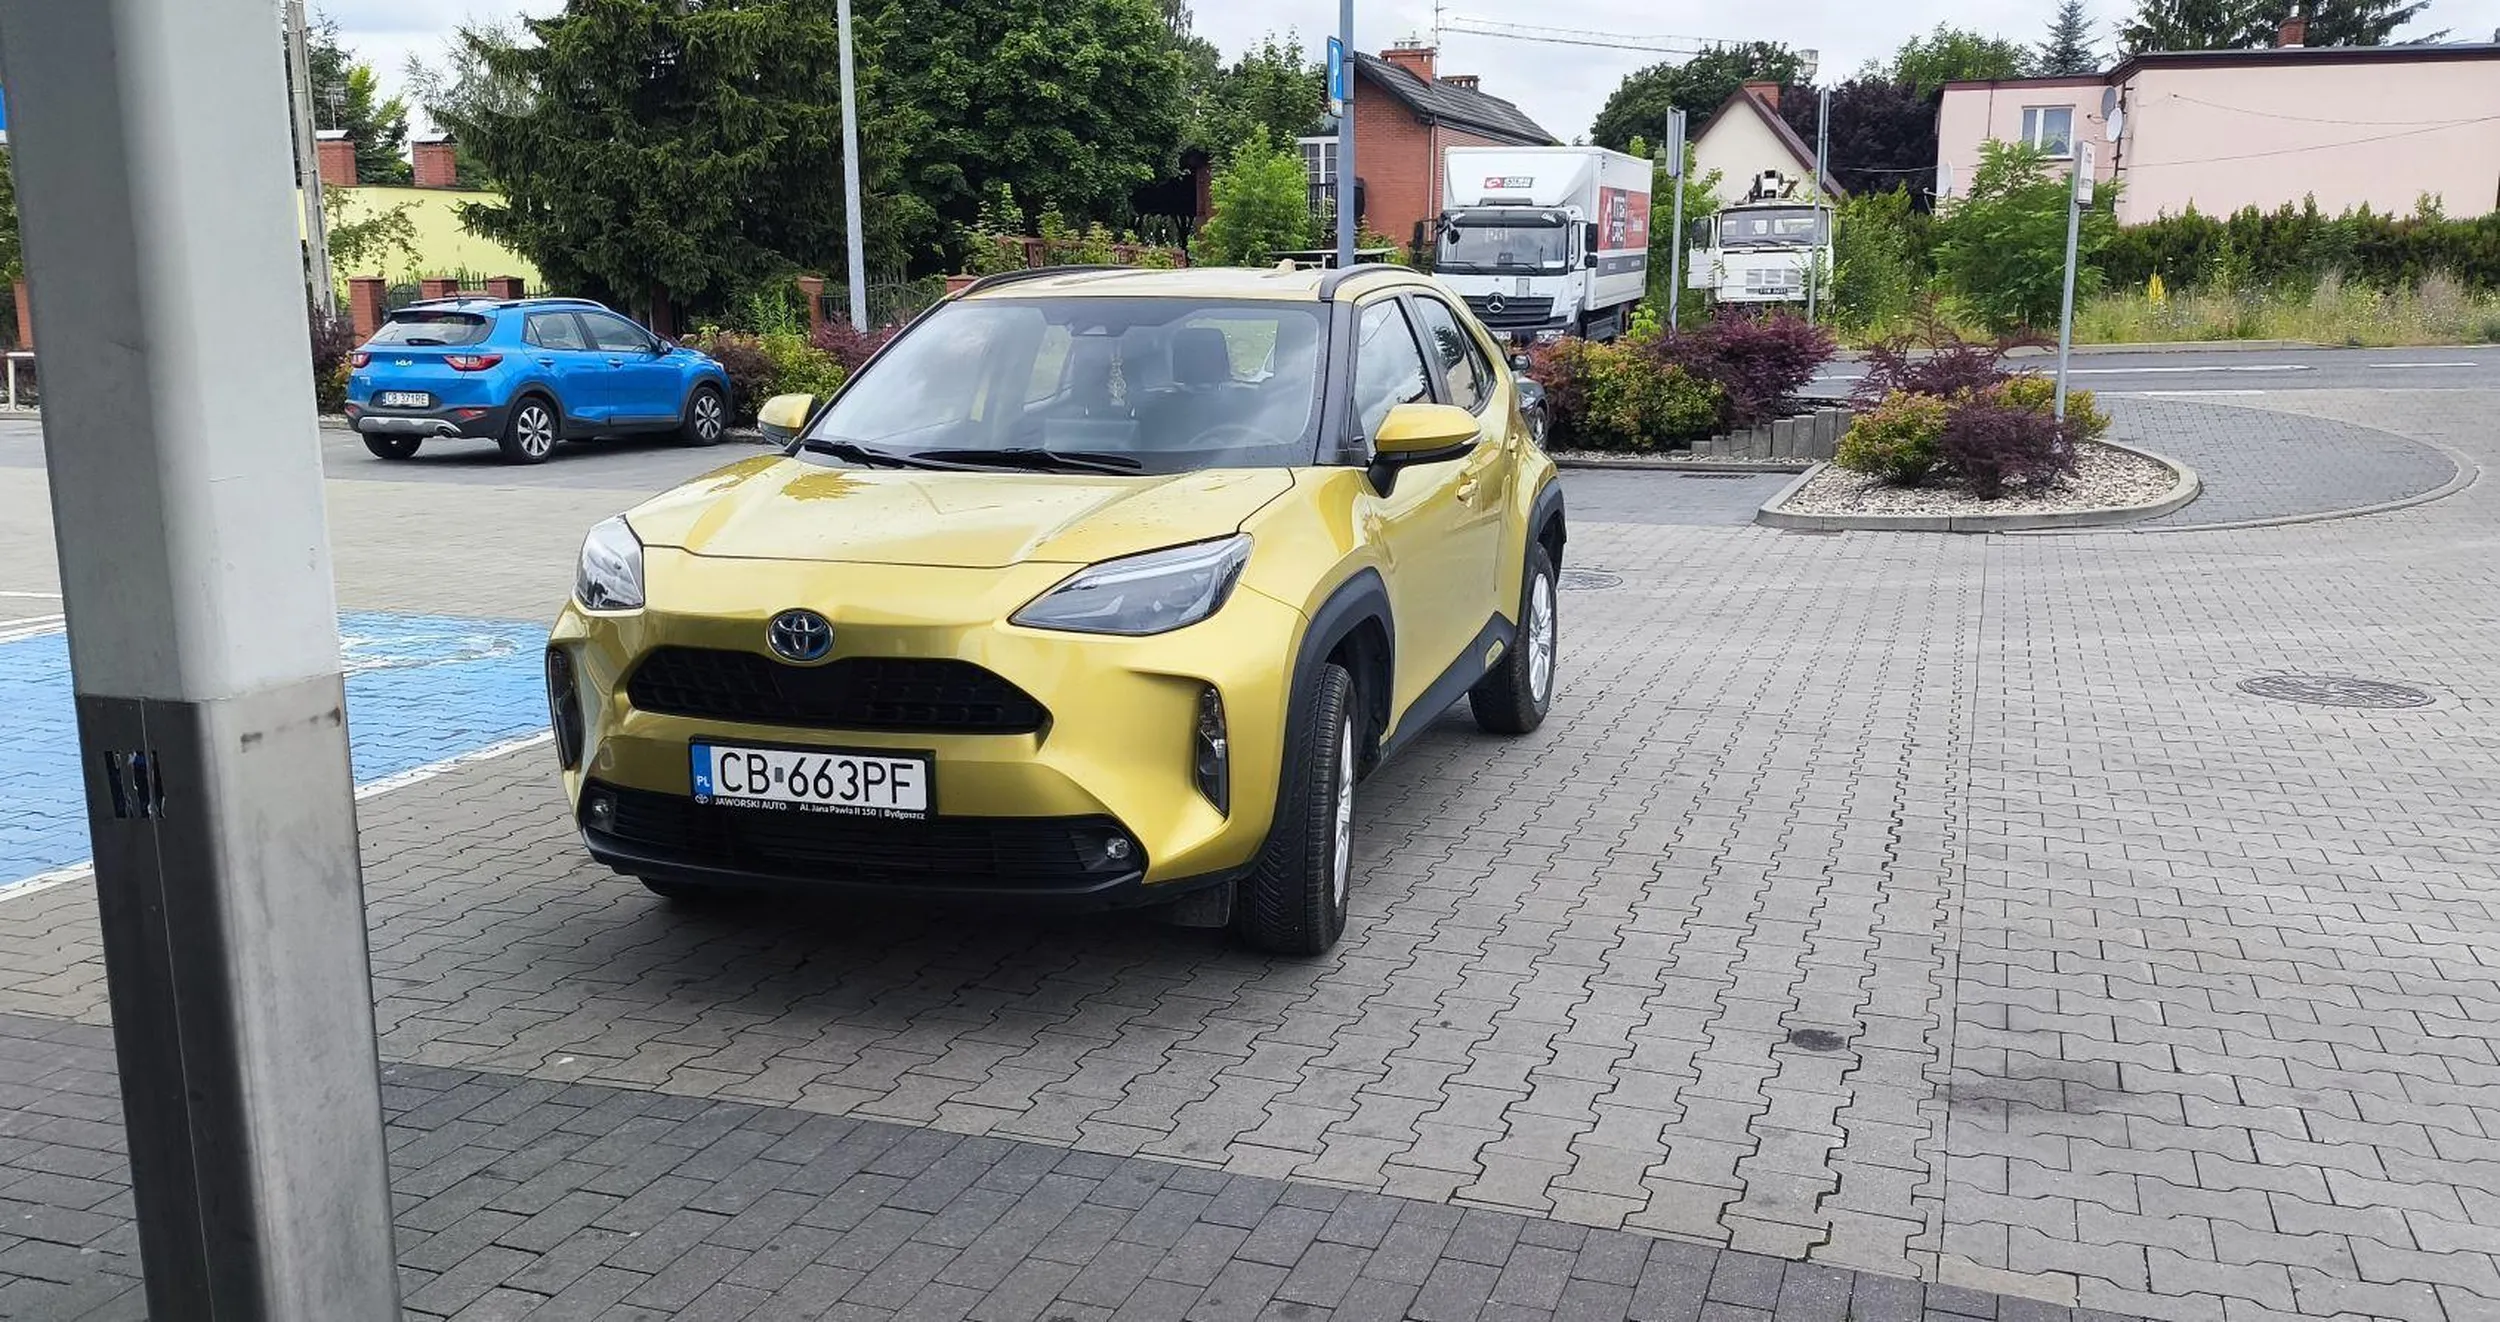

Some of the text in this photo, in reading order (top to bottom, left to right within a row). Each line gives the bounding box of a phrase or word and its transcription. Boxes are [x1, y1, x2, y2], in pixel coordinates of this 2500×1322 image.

[697, 776, 710, 788] PL
[720, 753, 914, 804] CB 663PF
[715, 797, 760, 807] JAWORSKI
[762, 800, 787, 811] AUTO
[811, 804, 829, 813] Jana
[861, 808, 877, 816] 150
[884, 809, 926, 820] Bydgoszcz
